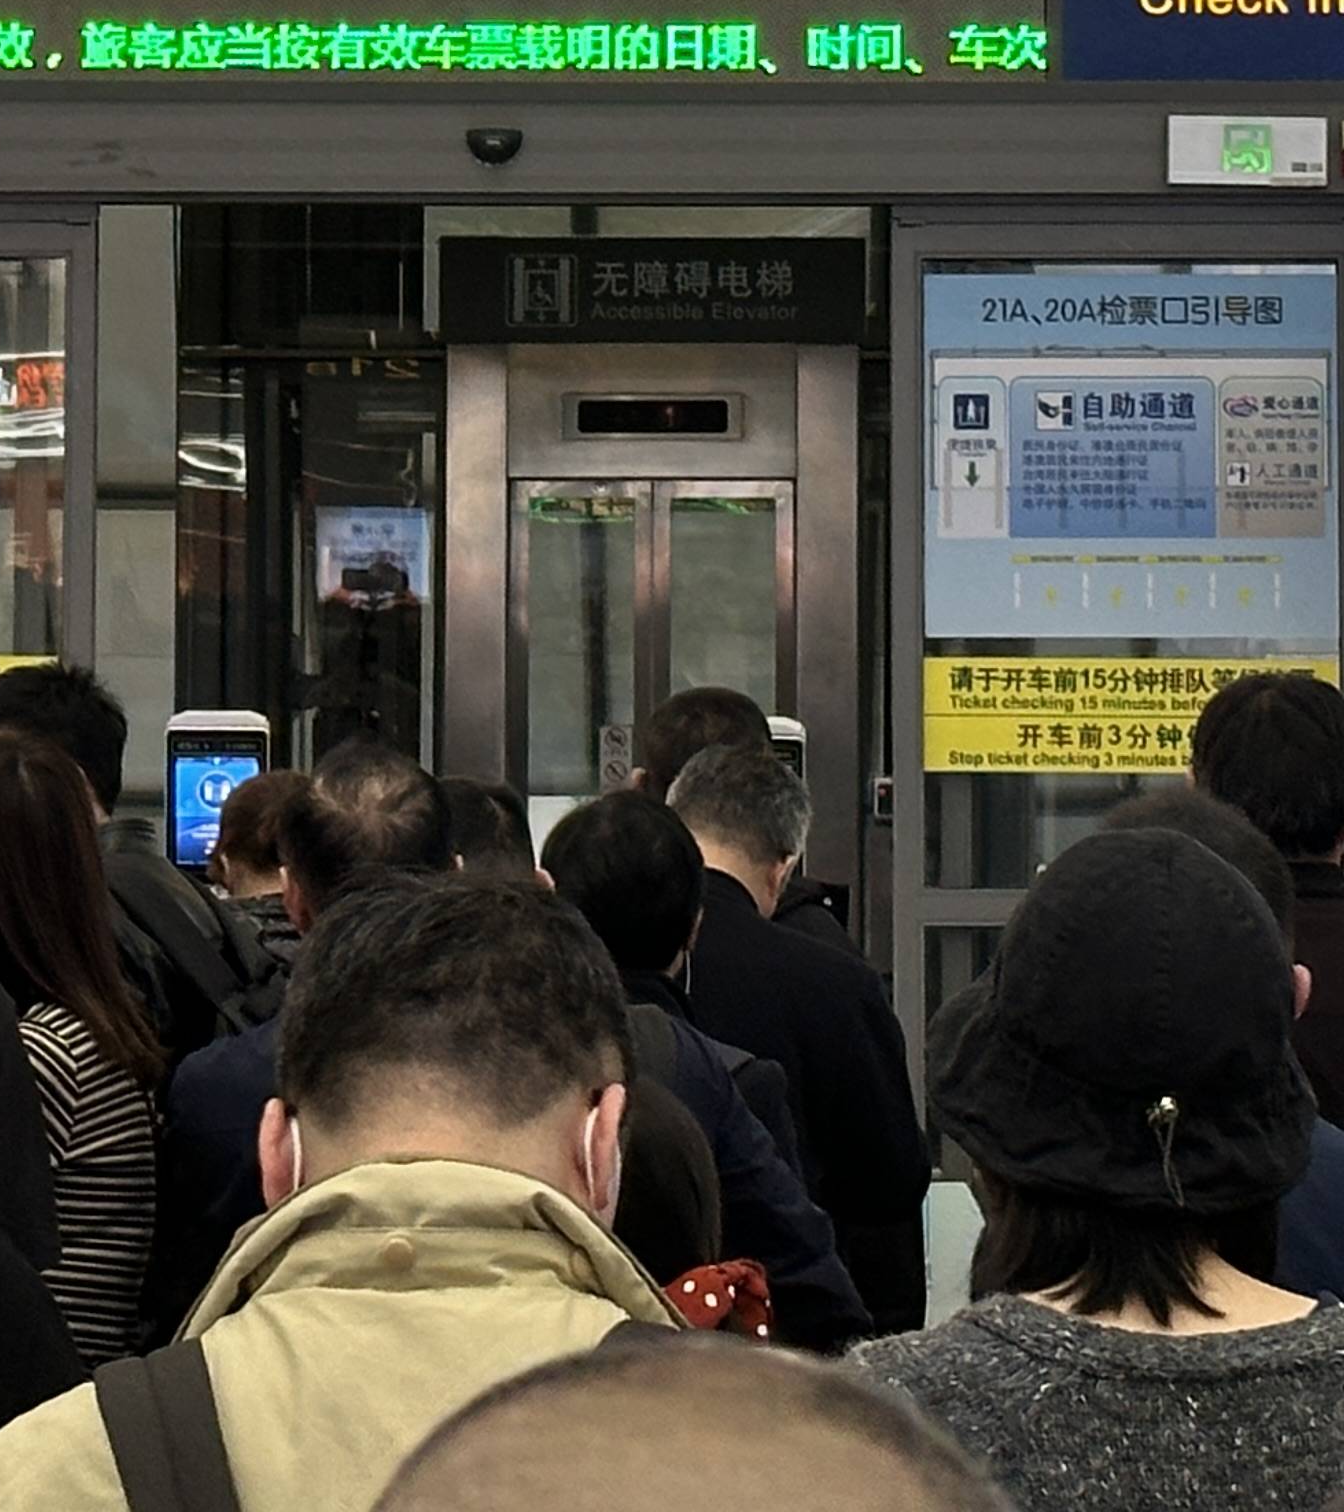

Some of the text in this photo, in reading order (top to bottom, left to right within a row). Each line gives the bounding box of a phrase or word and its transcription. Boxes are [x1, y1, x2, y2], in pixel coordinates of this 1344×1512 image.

[592, 260, 794, 299] 无障碍电梯
[591, 301, 799, 321] Accessible Elevator
[983, 295, 1284, 327] 21A、20A检票口引导图
[1084, 393, 1197, 421] 自助通道
[949, 664, 1315, 693] 请于开车前15分钟排队等
[950, 694, 998, 711] Ticket
[1002, 694, 1075, 713] checking
[1080, 695, 1099, 710] 15
[1102, 694, 1167, 710] minutes
[948, 751, 984, 770] Stop
[988, 751, 1029, 767] ticket
[1033, 751, 1100, 770] checking
[1104, 751, 1114, 766] 3
[1116, 751, 1177, 767] minutes
